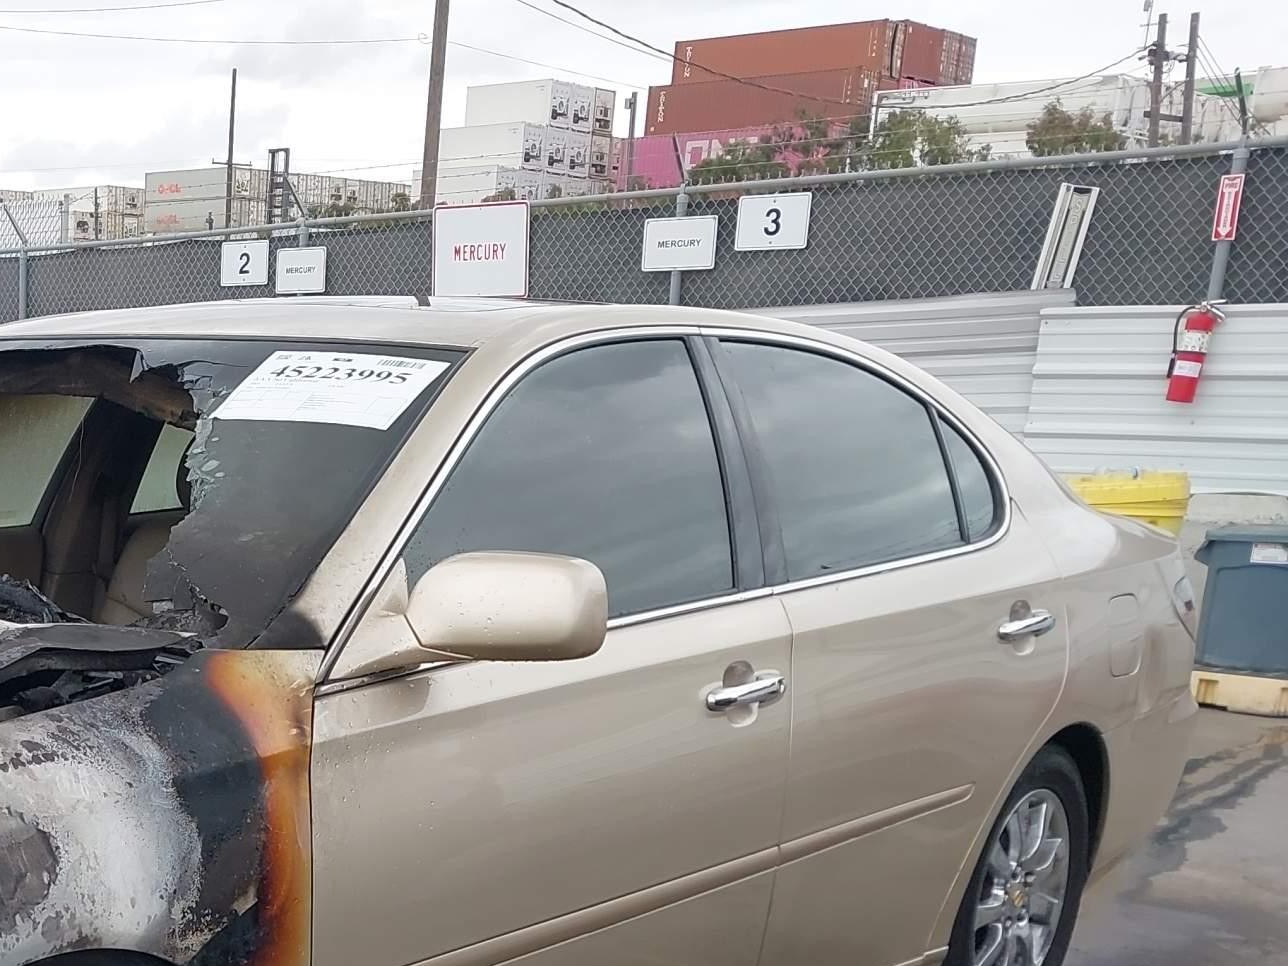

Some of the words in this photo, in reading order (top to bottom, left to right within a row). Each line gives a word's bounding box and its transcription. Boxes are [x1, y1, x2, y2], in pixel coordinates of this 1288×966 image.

[763, 208, 782, 236] 3
[454, 243, 506, 261] MERCURY
[657, 239, 702, 249] MERCURY
[239, 252, 250, 274] 2
[285, 266, 316, 274] MERCURY
[270, 364, 413, 384] 45223995
